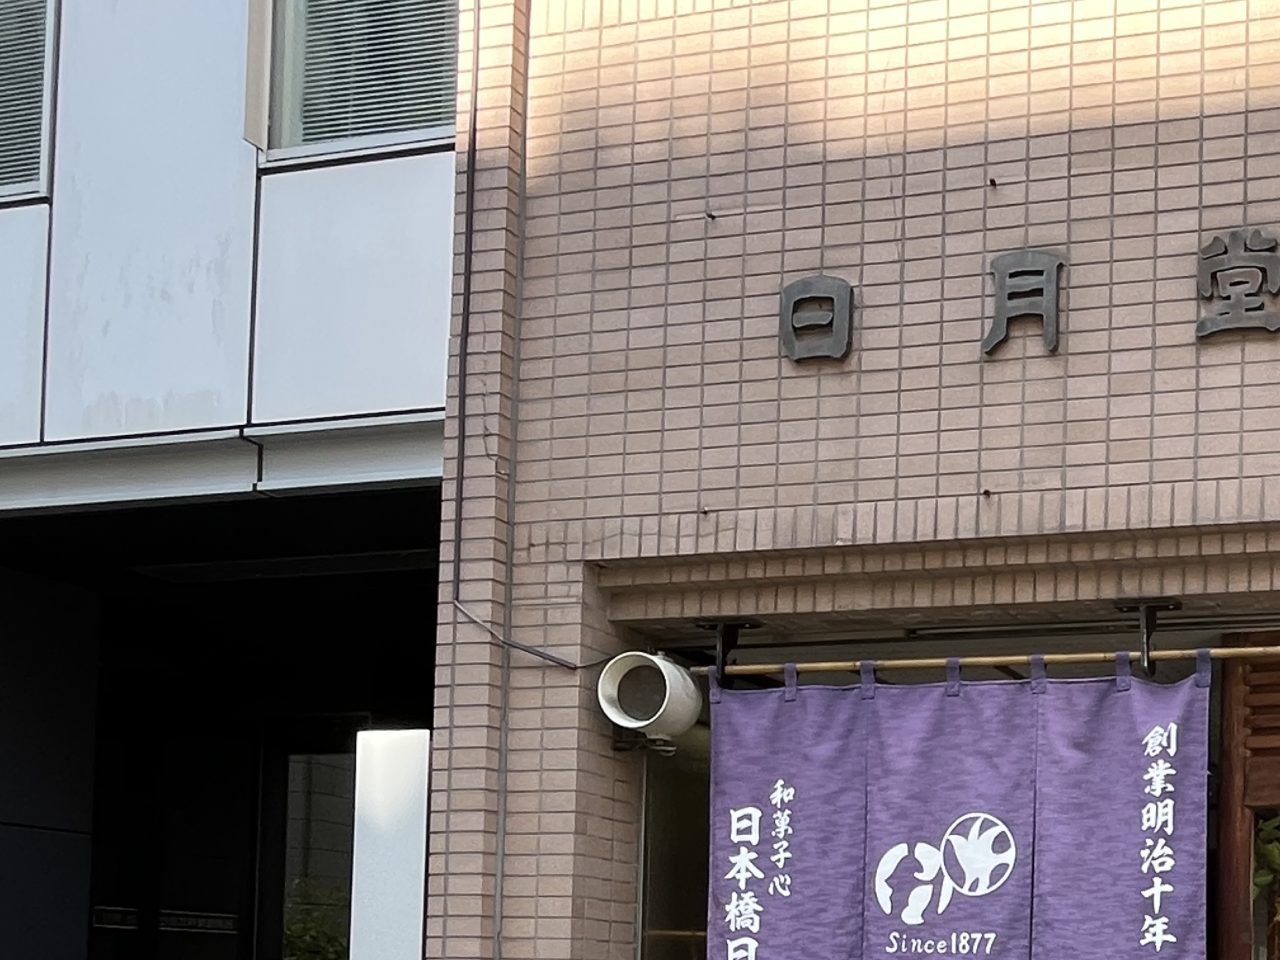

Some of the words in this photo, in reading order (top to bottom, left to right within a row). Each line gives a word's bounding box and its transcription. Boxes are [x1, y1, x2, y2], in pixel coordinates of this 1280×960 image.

[768, 778, 795, 897] 和菓子心
[1139, 722, 1180, 952] 創業明治十年
